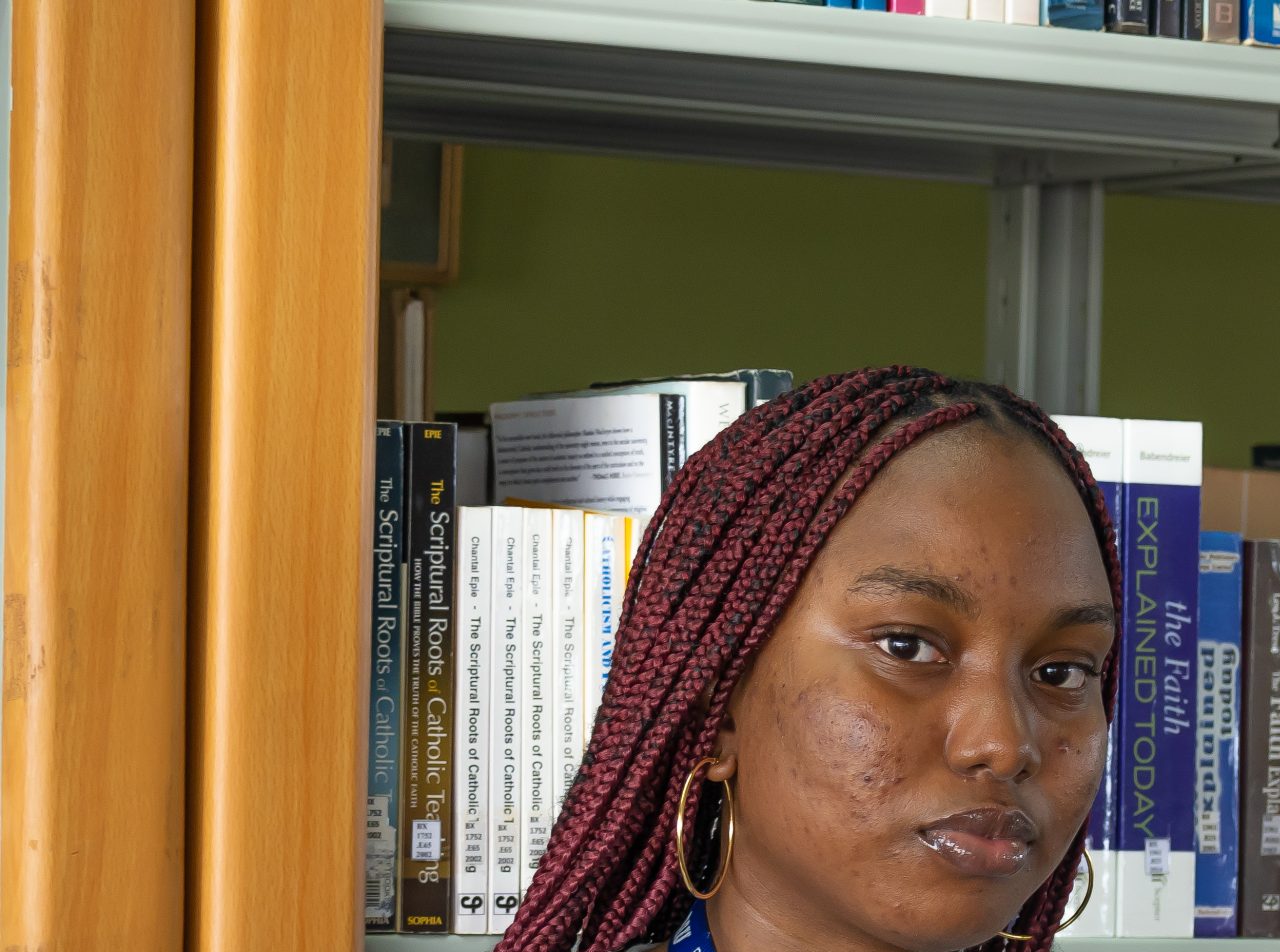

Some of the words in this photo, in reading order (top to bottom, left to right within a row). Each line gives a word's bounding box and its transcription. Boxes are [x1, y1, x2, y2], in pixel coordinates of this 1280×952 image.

[424, 430, 442, 439] EPIE
[380, 478, 393, 503] The
[431, 480, 445, 505] The
[374, 510, 399, 609] Scriptural
[424, 510, 450, 611] Scriptural
[471, 536, 480, 573] Chantal
[506, 537, 515, 573] Chantal
[532, 534, 540, 571] Chantal
[414, 558, 422, 582] HOW
[530, 574, 540, 595] Epie
[413, 583, 421, 599] THE
[469, 576, 480, 597] Epie
[505, 577, 514, 598] Epie
[1134, 496, 1158, 704] EXPLAINED
[413, 600, 421, 624] BIBLE
[470, 616, 480, 639] The
[506, 617, 516, 639] The
[532, 613, 543, 637] The
[1163, 600, 1192, 647] the
[377, 617, 394, 675] Roots
[412, 626, 421, 658] PROVES
[428, 618, 448, 676] Roots
[601, 639, 613, 667] AND
[412, 659, 420, 672] THE
[467, 643, 481, 703] Scriptural
[503, 644, 516, 704] Scriptural
[530, 640, 543, 701] Scriptural
[376, 679, 388, 691] of
[411, 673, 419, 705] TRUTH
[426, 680, 438, 692] of
[1163, 656, 1191, 735] Faith
[410, 720, 419, 737] THE
[411, 707, 419, 718] OF
[469, 708, 480, 743] Roots
[504, 708, 515, 744] Roots
[532, 705, 542, 741] Roots
[375, 696, 395, 784] Catholic
[427, 697, 447, 785] Catholic
[468, 748, 480, 759] of
[503, 748, 515, 760] of
[532, 744, 543, 756] of
[410, 738, 419, 781] CATHOLIC
[468, 766, 480, 815] Catholic
[503, 766, 515, 815] Catholic
[531, 762, 543, 811] Catholic
[1134, 713, 1156, 839] TODAY
[410, 783, 418, 808] FAITH
[419, 789, 446, 884] Teang
[407, 916, 442, 926] SOPHIA
